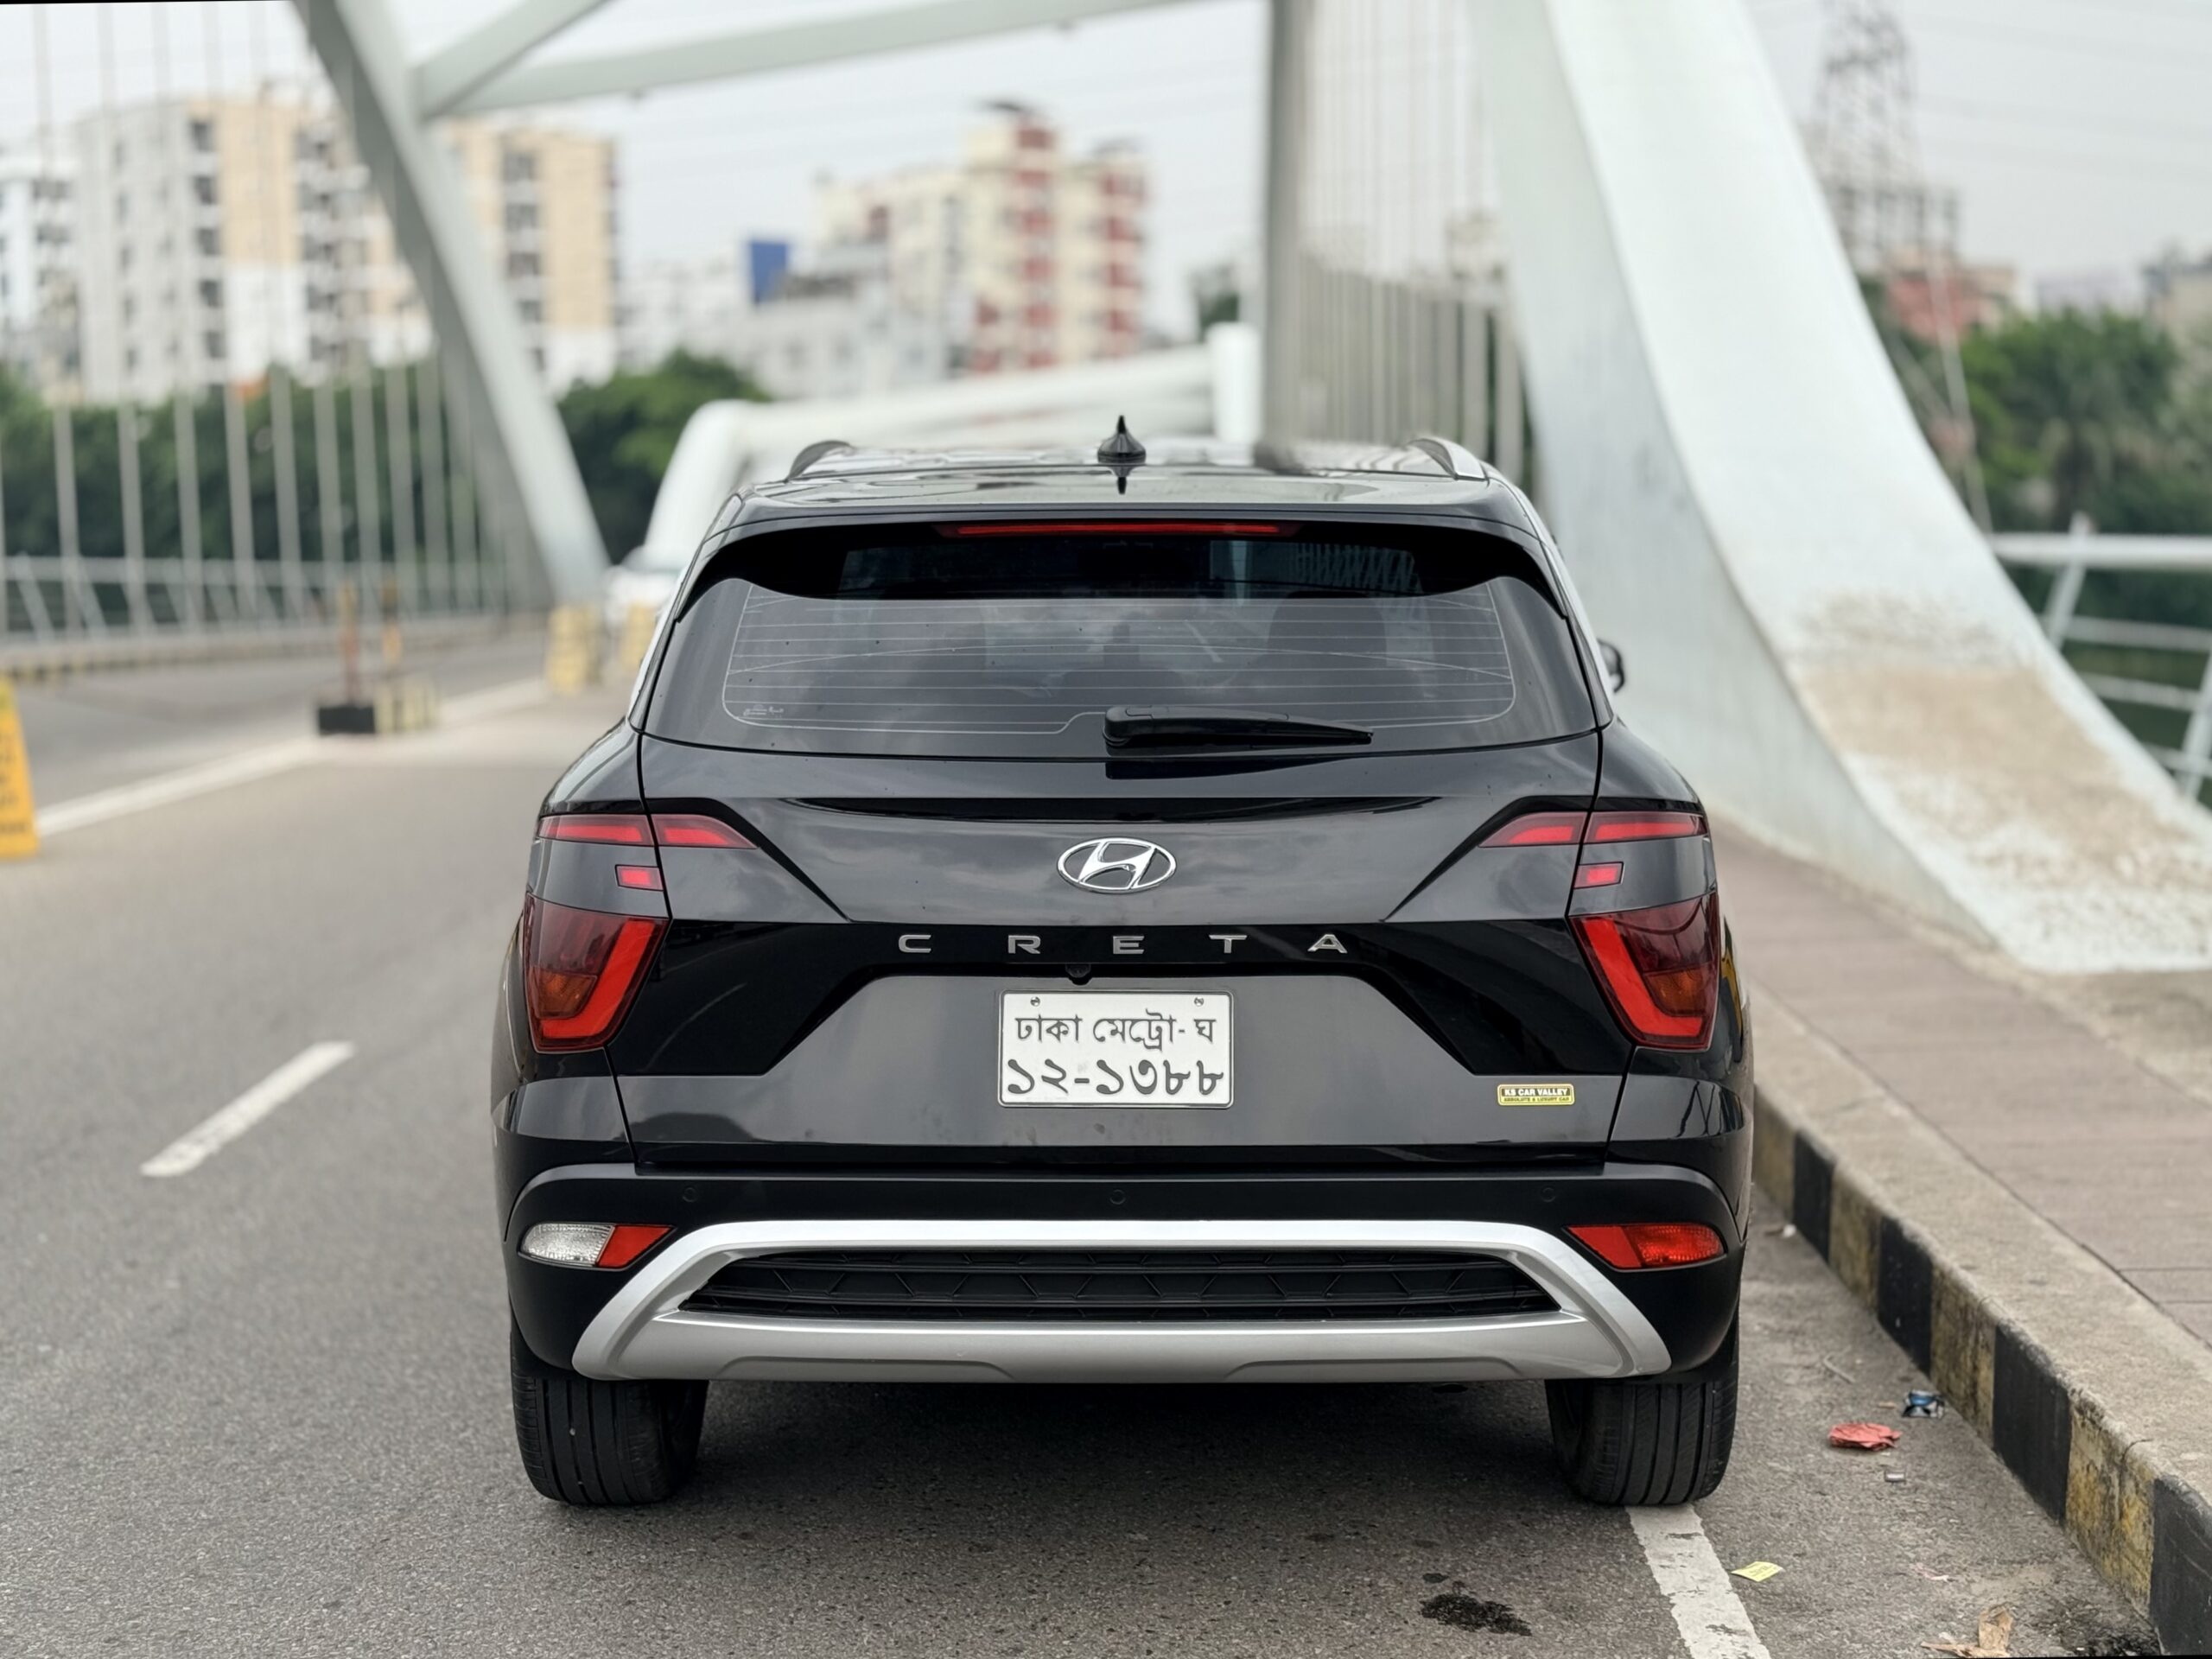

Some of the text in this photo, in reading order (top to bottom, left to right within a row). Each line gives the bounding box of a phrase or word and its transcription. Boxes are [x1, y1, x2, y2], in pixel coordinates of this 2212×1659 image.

[898, 934, 1348, 955] CRETA
[1014, 1014, 1084, 1043] ঢাকা
[1007, 1058, 1224, 1096] ১২-১৩৮৮
